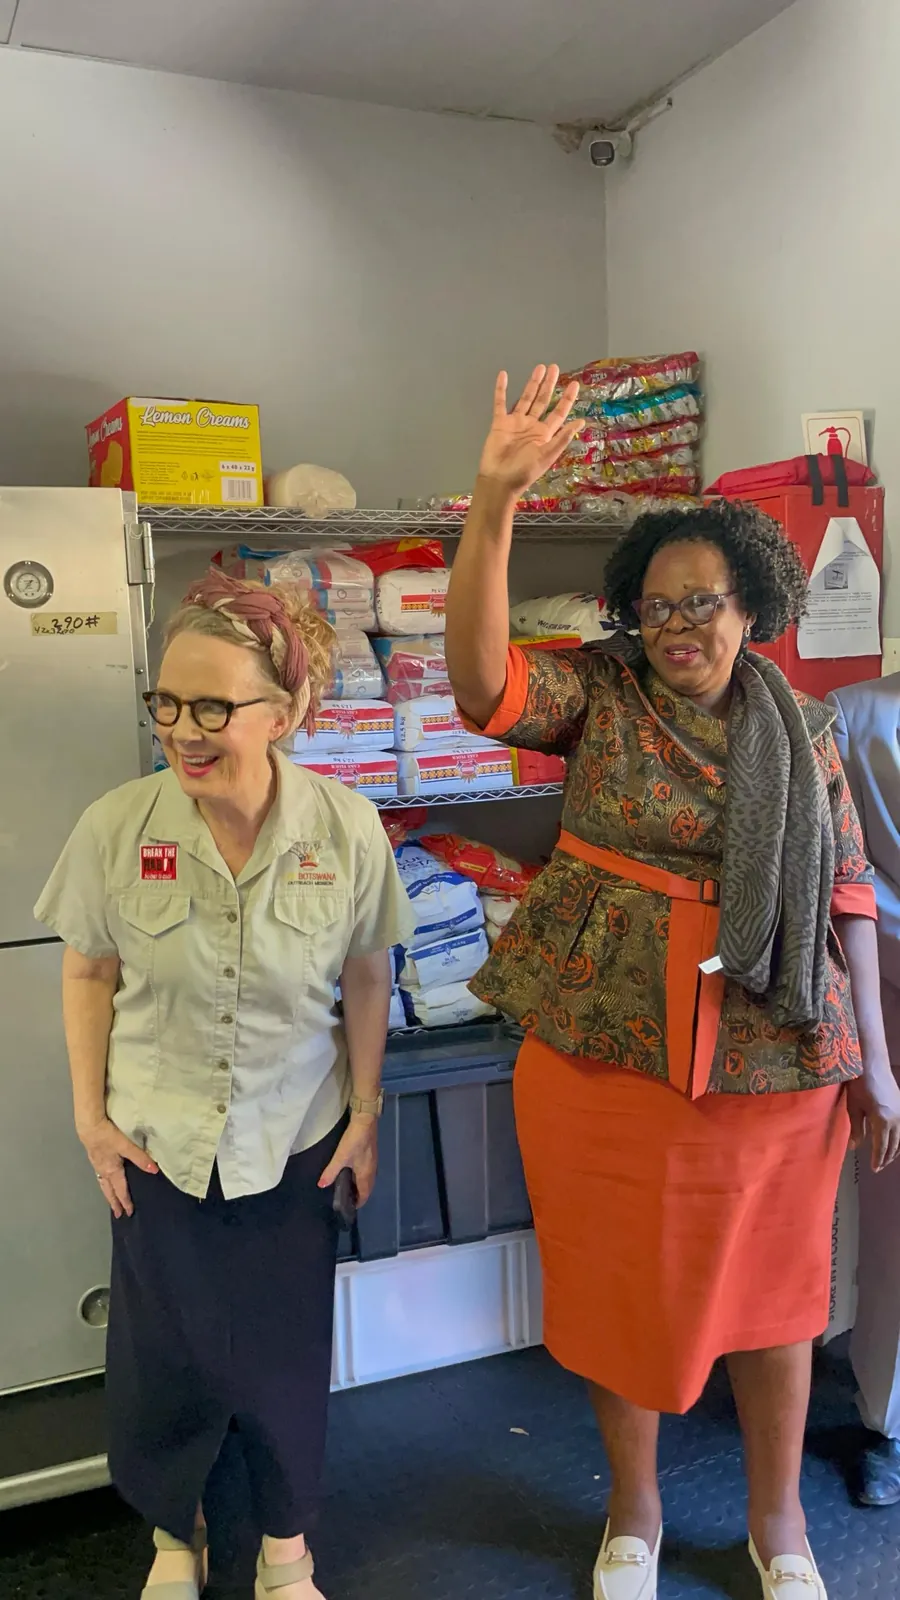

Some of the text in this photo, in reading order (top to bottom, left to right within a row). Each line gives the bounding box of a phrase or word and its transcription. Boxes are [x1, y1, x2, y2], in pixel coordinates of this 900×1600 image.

[140, 405, 250, 429] Lemon Creams
[400, 716, 406, 726] kg
[143, 848, 175, 858] BREAK THE
[298, 872, 337, 881] BOTSWANA
